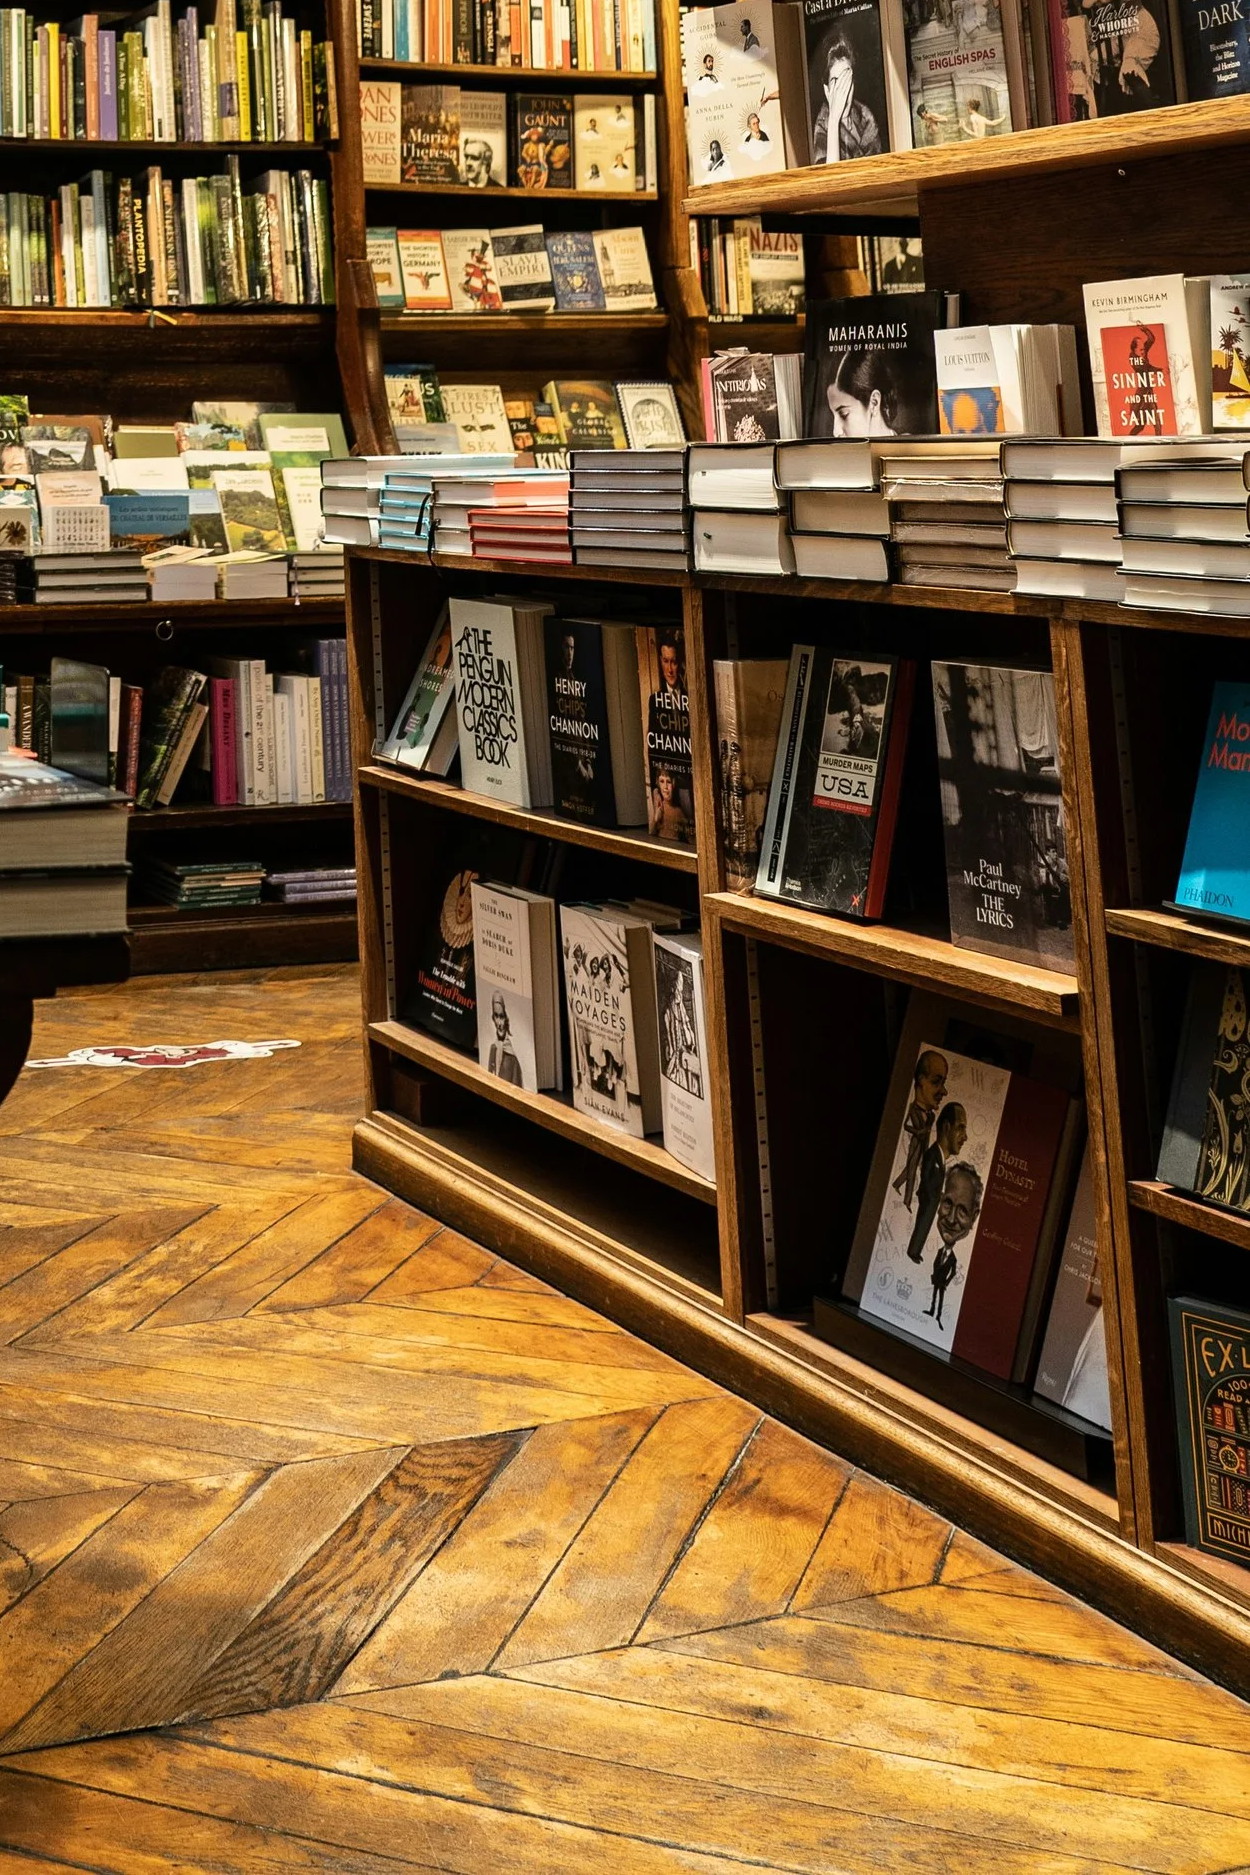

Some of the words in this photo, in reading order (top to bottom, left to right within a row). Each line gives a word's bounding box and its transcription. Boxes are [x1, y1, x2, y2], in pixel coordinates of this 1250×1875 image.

[825, 0, 832, 9] a
[1198, 0, 1244, 30] DARK
[1089, 3, 1138, 28] Harlots
[1098, 16, 1140, 32] WHORES
[929, 55, 969, 71] ENGLISH
[971, 48, 997, 62] SPAS
[409, 128, 449, 143] Maria
[402, 143, 457, 159] Theresa
[134, 199, 146, 274] PLANTOPEDIA
[751, 227, 798, 251] NAZIS
[1092, 298, 1113, 307] KEVIN
[1117, 293, 1168, 305] BIRMINGHAM
[829, 322, 908, 342] MAHARANIS
[829, 344, 851, 352] WOMEN
[854, 343, 862, 351] OF
[865, 342, 885, 350] ROYAL
[888, 341, 908, 349] INDIA
[1129, 357, 1144, 366] THE
[1112, 371, 1166, 389] SINNER
[1125, 394, 1140, 404] AND
[1143, 394, 1158, 403] THE
[1121, 409, 1165, 425] SAINT
[467, 441, 497, 453] SEX
[471, 628, 493, 656] THE
[459, 652, 513, 687] PENGUIN
[458, 679, 515, 715] MODERN
[555, 677, 587, 698] HENRY
[654, 692, 689, 712] HENR
[462, 705, 518, 743] CLASSICS
[550, 715, 599, 740] CHANNON
[475, 734, 511, 768] BOOK
[646, 731, 692, 756] CHANN
[823, 757, 852, 769] MURDER
[853, 762, 873, 773] MAPS
[821, 775, 869, 799] USA
[979, 858, 1003, 876] Paul
[963, 870, 1022, 899] McCartney
[981, 894, 1005, 912] THE
[1184, 888, 1234, 908] PHAIDON
[976, 907, 1014, 929] LYRICS
[569, 981, 621, 1011] MAIDEN
[568, 997, 627, 1032] VOYAGES
[601, 1106, 626, 1123] EVANS
[999, 1148, 1029, 1172] HOTEL
[995, 1164, 1036, 1191] DYNASTY
[1217, 1389, 1243, 1403] READ
